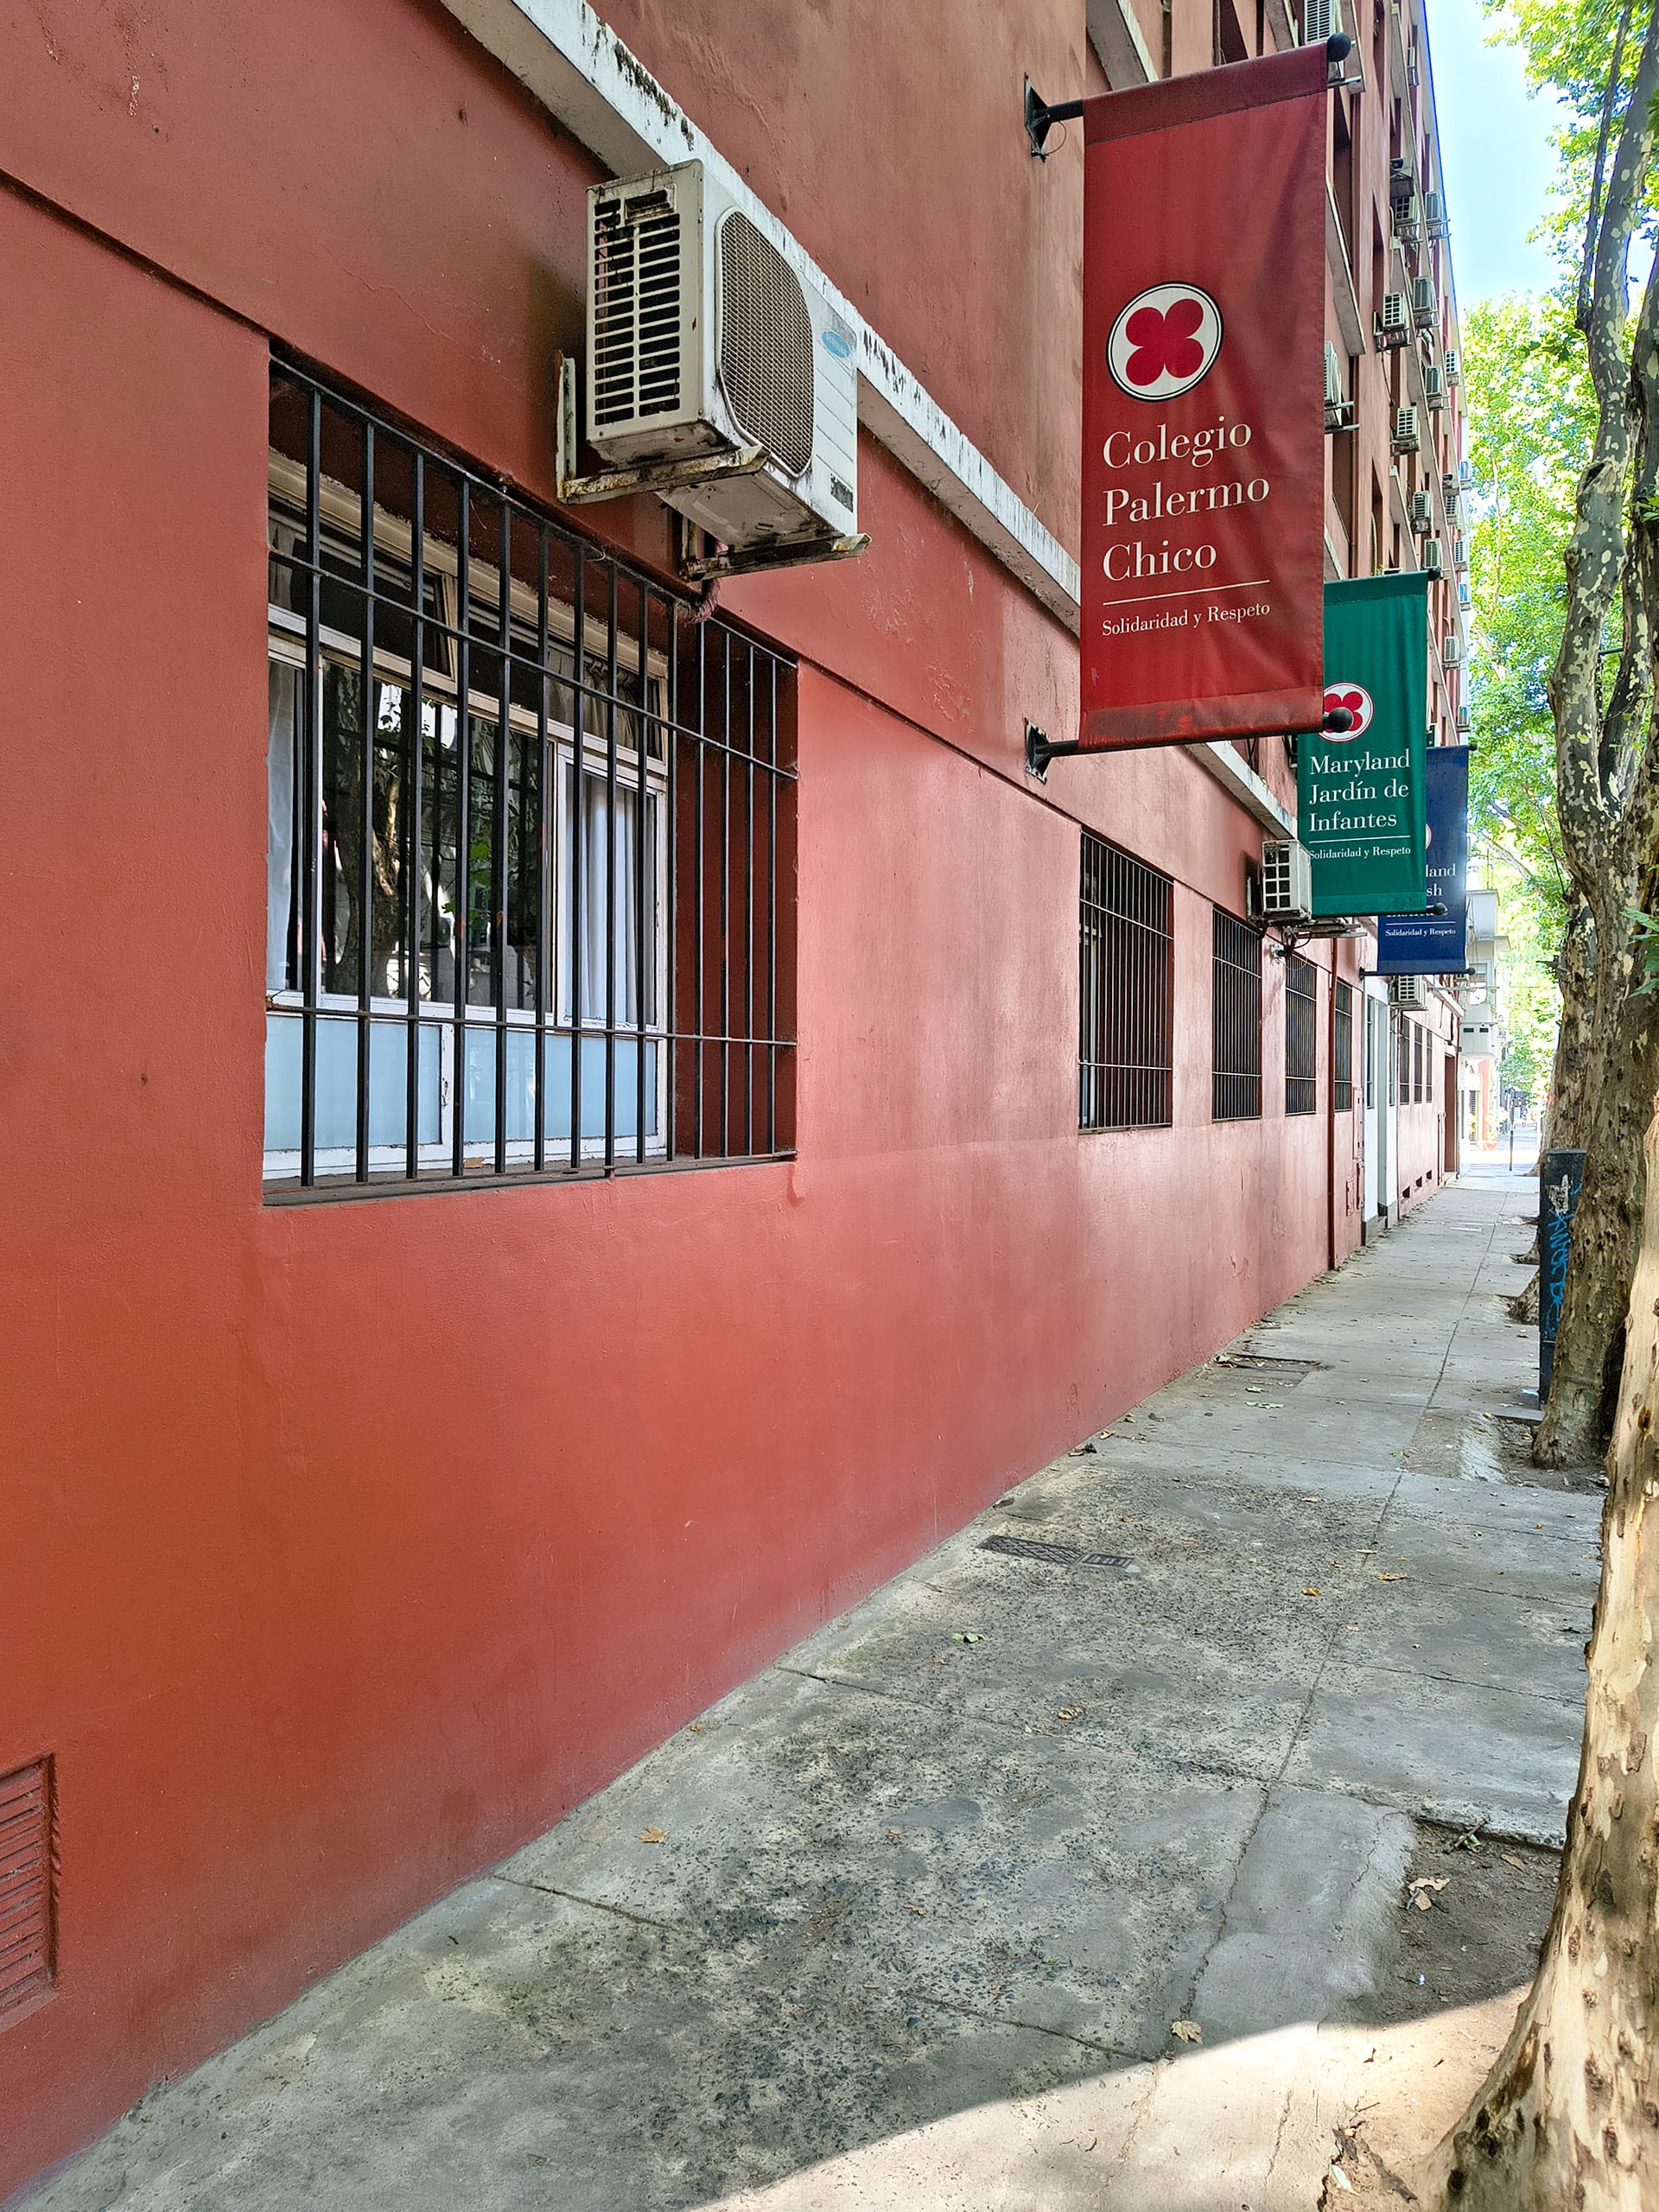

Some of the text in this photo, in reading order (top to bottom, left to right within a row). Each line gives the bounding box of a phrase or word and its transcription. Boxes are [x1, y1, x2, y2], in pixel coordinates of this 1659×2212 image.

[1103, 416, 1252, 468] Colegio
[1102, 478, 1270, 526] Palermo
[1103, 540, 1217, 582] Chico
[1102, 603, 1270, 636] Solidaridad y Respeto
[1309, 748, 1411, 778] Maryland
[1309, 778, 1409, 805] Jardín de
[1308, 810, 1397, 832] Infantes
[1309, 846, 1412, 860] Solidaridad y Respeto
[1425, 863, 1457, 878] land
[1385, 928, 1422, 938] Solidaridad
[1429, 927, 1457, 937] Respeto
